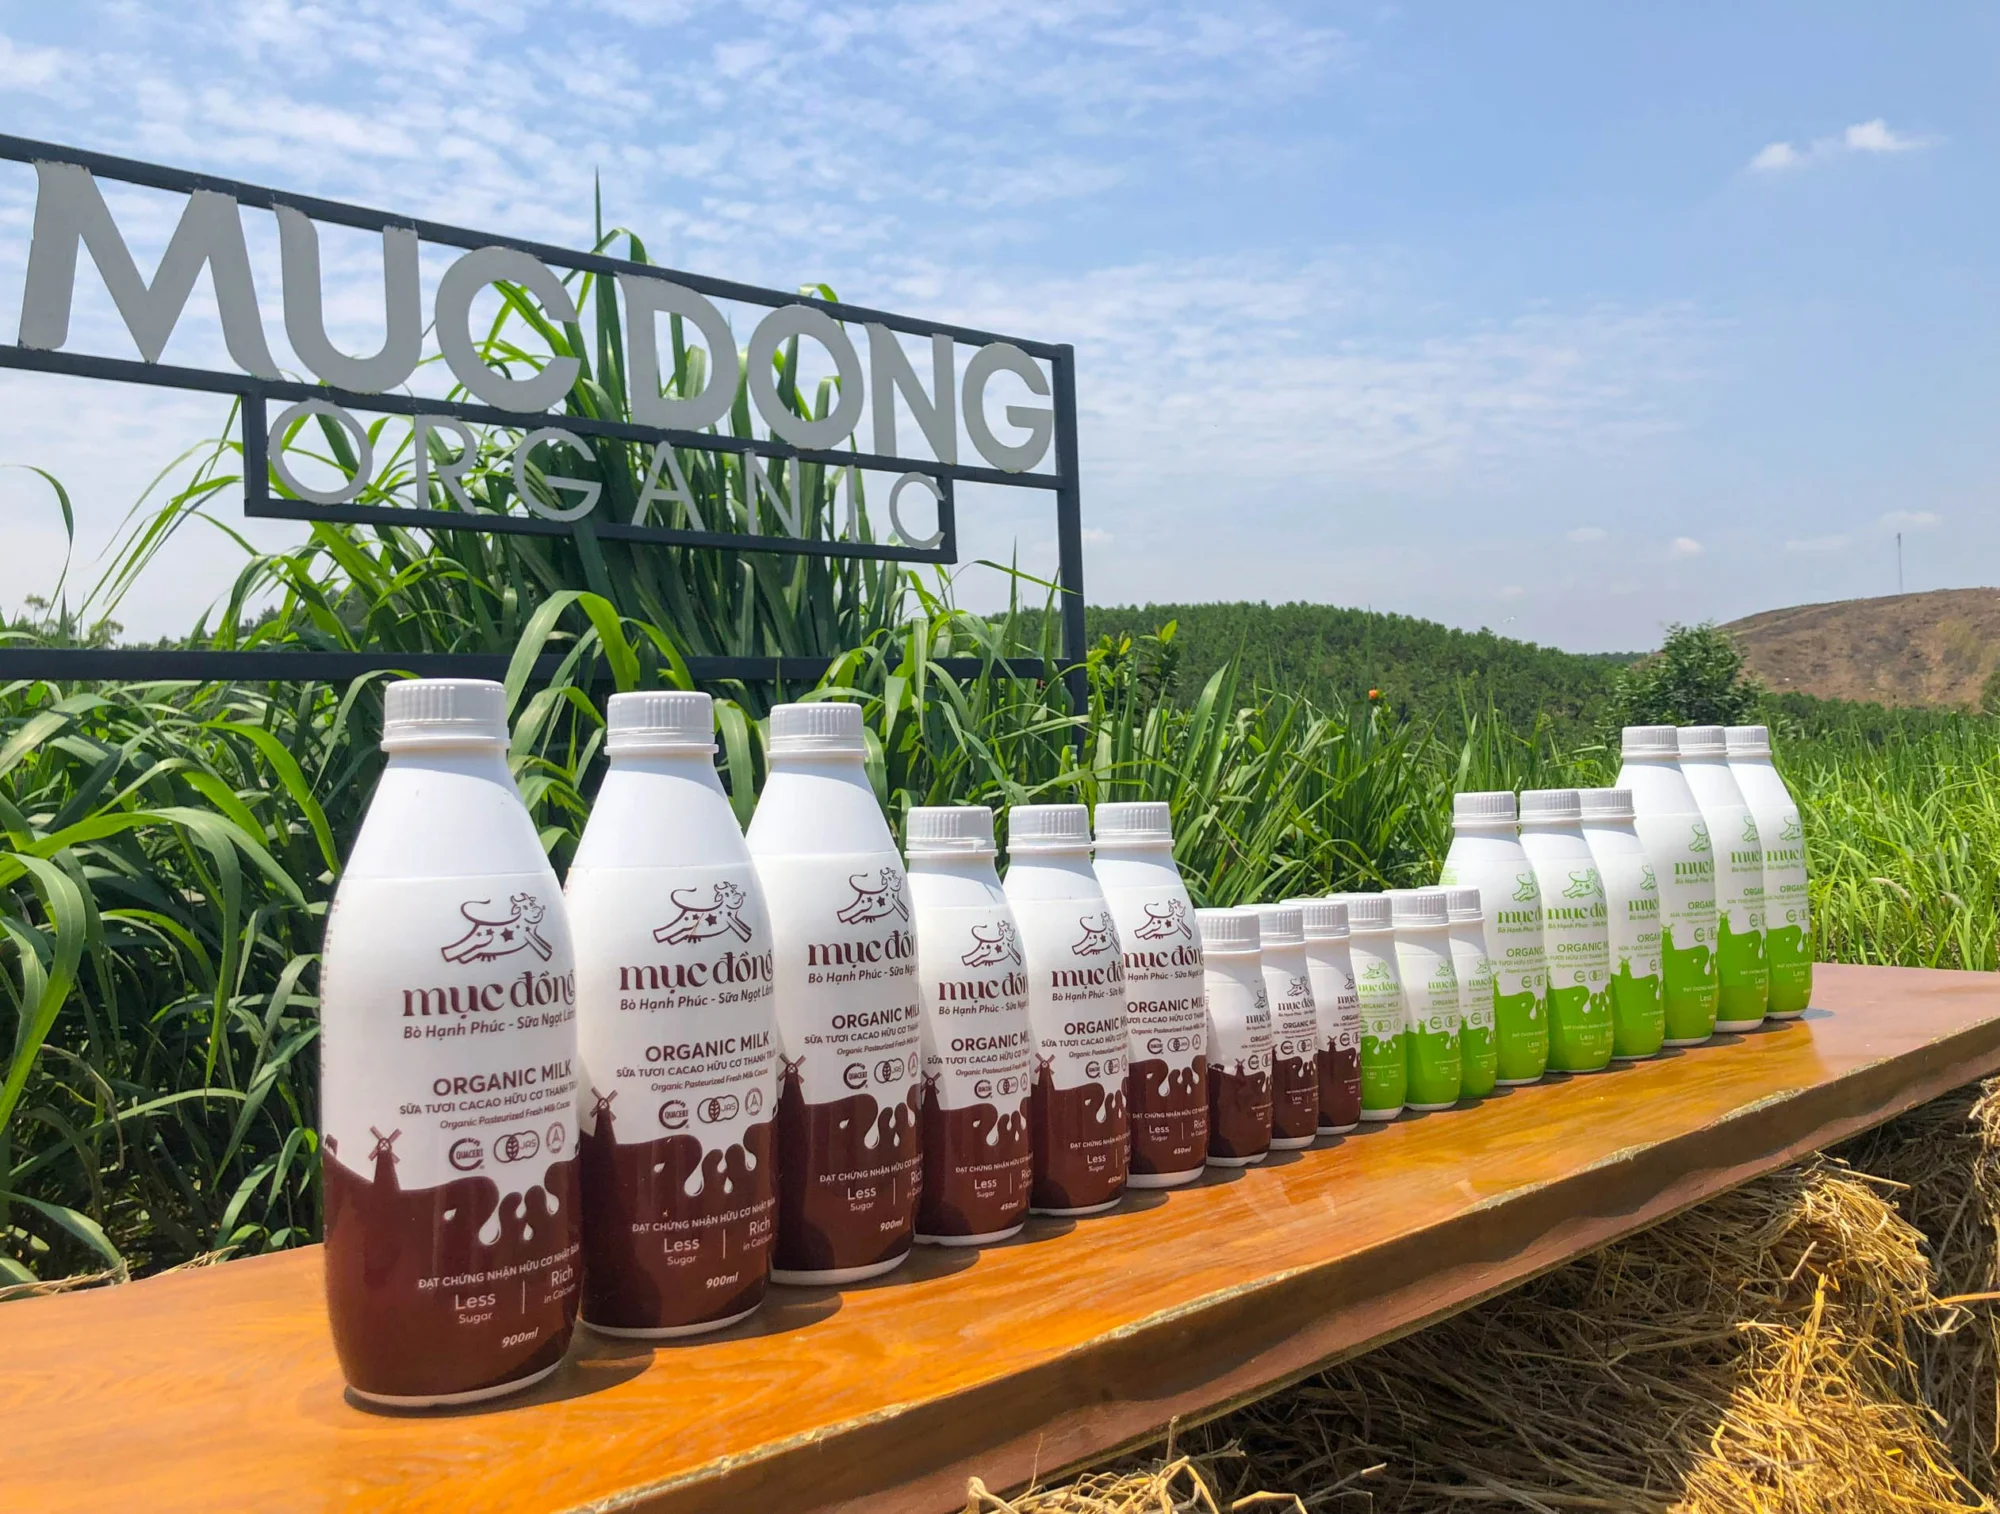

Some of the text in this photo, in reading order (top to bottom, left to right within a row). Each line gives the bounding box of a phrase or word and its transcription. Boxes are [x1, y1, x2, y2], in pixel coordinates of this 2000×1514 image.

[19, 160, 1052, 474] MUC DONG
[269, 399, 945, 550] ORGANIC
[1498, 910, 1533, 925] mục
[1548, 908, 1587, 922] mục
[1637, 932, 1660, 942] ORGA
[808, 941, 881, 968] mục
[1557, 942, 1601, 952] ORGANIC
[620, 949, 773, 994] mục đồng
[808, 967, 903, 985] Bò Hạnh Phúc Sữa
[1052, 967, 1105, 989] mục
[1128, 971, 1168, 982] Hạnh Phúc
[939, 980, 999, 1003] mục
[1053, 988, 1104, 1002] Bò Hạnh Phúc
[402, 983, 504, 1019] mục
[620, 989, 761, 1012] Bò Hạnh Phúc Sữa Ngọt
[1127, 999, 1188, 1013] ORGANIC
[939, 1002, 999, 1016] Bò Hạnh Phúc
[404, 1013, 562, 1040] Bò Hạnh Phúc Sữa Ngọt
[832, 1008, 902, 1029] ORGANIC
[1065, 1018, 1119, 1035] ORGANIC
[1283, 1020, 1308, 1029] ORGANIC
[805, 1026, 906, 1044] SỮA TƯƠI CACAO HỮU CƠ
[951, 1034, 1018, 1051] ORGANIC
[1041, 1037, 1104, 1047] SỮA TƯƠI CACAO
[646, 1031, 769, 1062] ORGANIC MILK
[837, 1047, 862, 1056] Organic
[928, 1056, 943, 1064] SỮA
[970, 1055, 997, 1064] CACAO
[1069, 1051, 1090, 1059] Organic
[617, 1067, 636, 1077] SỮA
[639, 1068, 664, 1077] TƯƠI
[668, 1064, 704, 1075] CACAO
[707, 1060, 727, 1072] HỮU
[730, 1058, 742, 1067] CƠ
[956, 1069, 980, 1077] Organic
[433, 1059, 571, 1096] ORGANIC MILK
[651, 1074, 741, 1092] Organic Pasteurized Fresh
[400, 1103, 422, 1115] SỮA
[425, 1103, 455, 1113] TƯƠI
[459, 1098, 500, 1111] CACAO
[504, 1093, 527, 1105] HỮU
[529, 1090, 543, 1100] CƠ
[545, 1084, 568, 1097] THANH
[721, 1103, 736, 1112] JAS
[440, 1120, 476, 1130] Organic
[479, 1111, 524, 1124] Pasteurized
[525, 1107, 543, 1117] Fresh
[1149, 1125, 1169, 1134] Less
[519, 1138, 536, 1149] JAS
[1087, 1154, 1106, 1164] Less
[820, 1162, 903, 1184] ĐẠT CHỨNG NHẬN HỮU
[970, 1164, 992, 1172] CHỨNG
[974, 1179, 997, 1190] Less
[848, 1187, 876, 1200] Less
[977, 1190, 995, 1198] Sugar
[850, 1202, 874, 1211] Sugar
[1001, 1200, 1019, 1211] 450ml
[632, 1223, 650, 1234] ĐẠT
[653, 1221, 689, 1231] CHỨNG
[692, 1215, 718, 1227] NHẬN
[720, 1211, 738, 1221] HỮU
[740, 1206, 751, 1217] CƠ
[750, 1216, 770, 1236] Rich
[880, 1216, 903, 1231] 900ml
[664, 1238, 700, 1252] Less
[667, 1256, 696, 1266] Sugar
[419, 1278, 440, 1290] ĐẠT
[442, 1273, 484, 1286] CHỨNG
[487, 1266, 516, 1280] NHẬN
[520, 1260, 539, 1273] HỮU
[541, 1255, 553, 1266] CƠ
[551, 1264, 573, 1286] Rich
[706, 1271, 739, 1288] 900ml
[455, 1293, 496, 1310] Less
[459, 1312, 492, 1324] Sugar
[502, 1327, 539, 1348] 900ml
